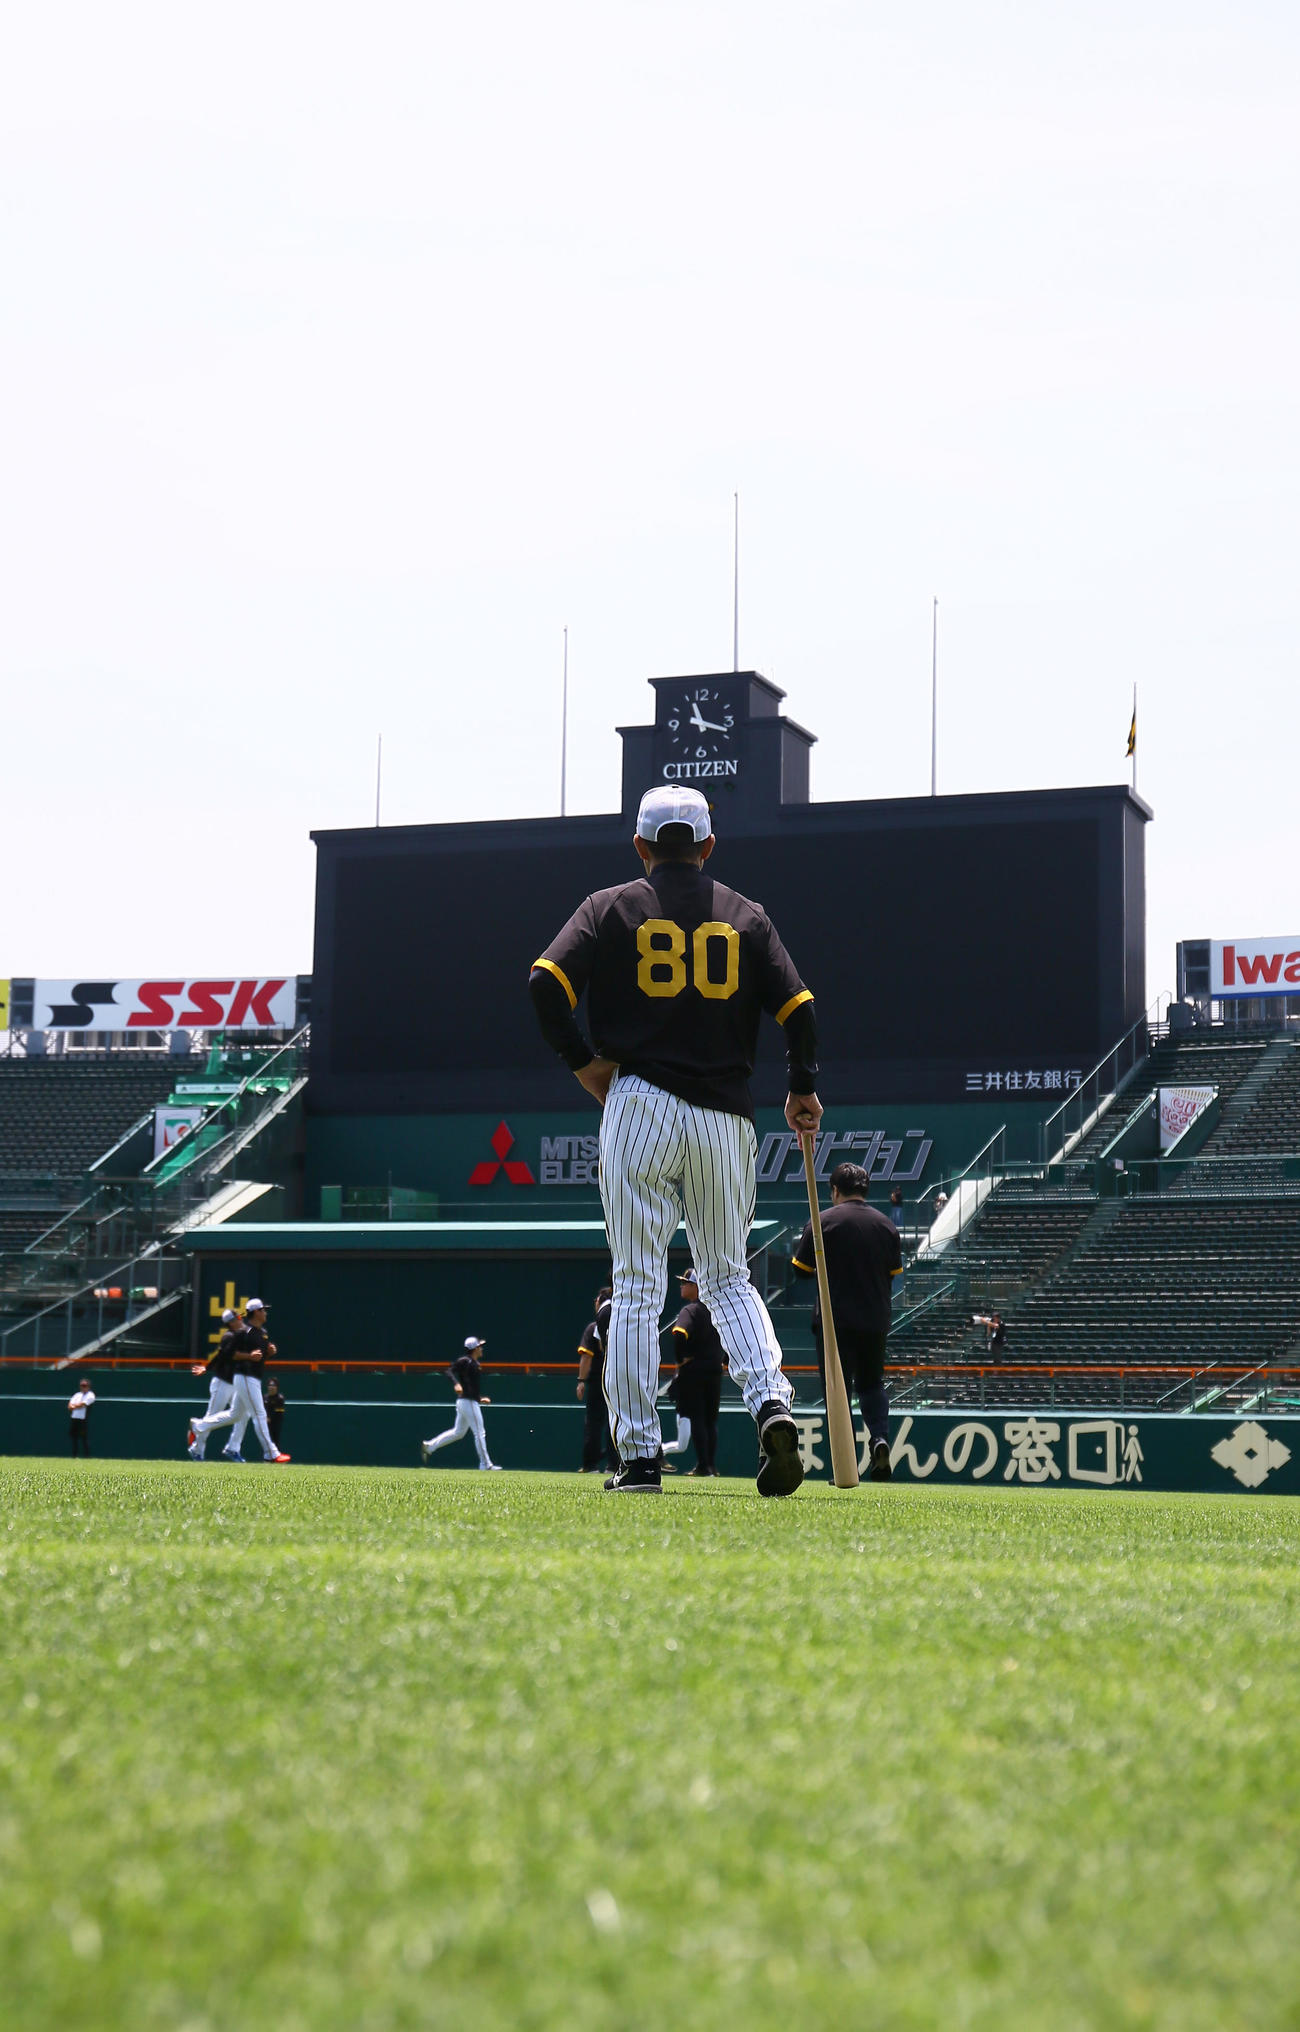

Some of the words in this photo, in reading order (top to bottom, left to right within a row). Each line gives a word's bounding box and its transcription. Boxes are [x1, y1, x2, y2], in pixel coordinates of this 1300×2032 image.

[695, 689, 709, 702] 12
[668, 719, 680, 731] 9
[723, 715, 735, 728] 3
[695, 746, 707, 758] 6
[663, 760, 739, 779] CITIZEN
[636, 918, 740, 1000] 80
[126, 980, 288, 1027] SSK
[965, 1069, 1083, 1091] 三井住友銀行
